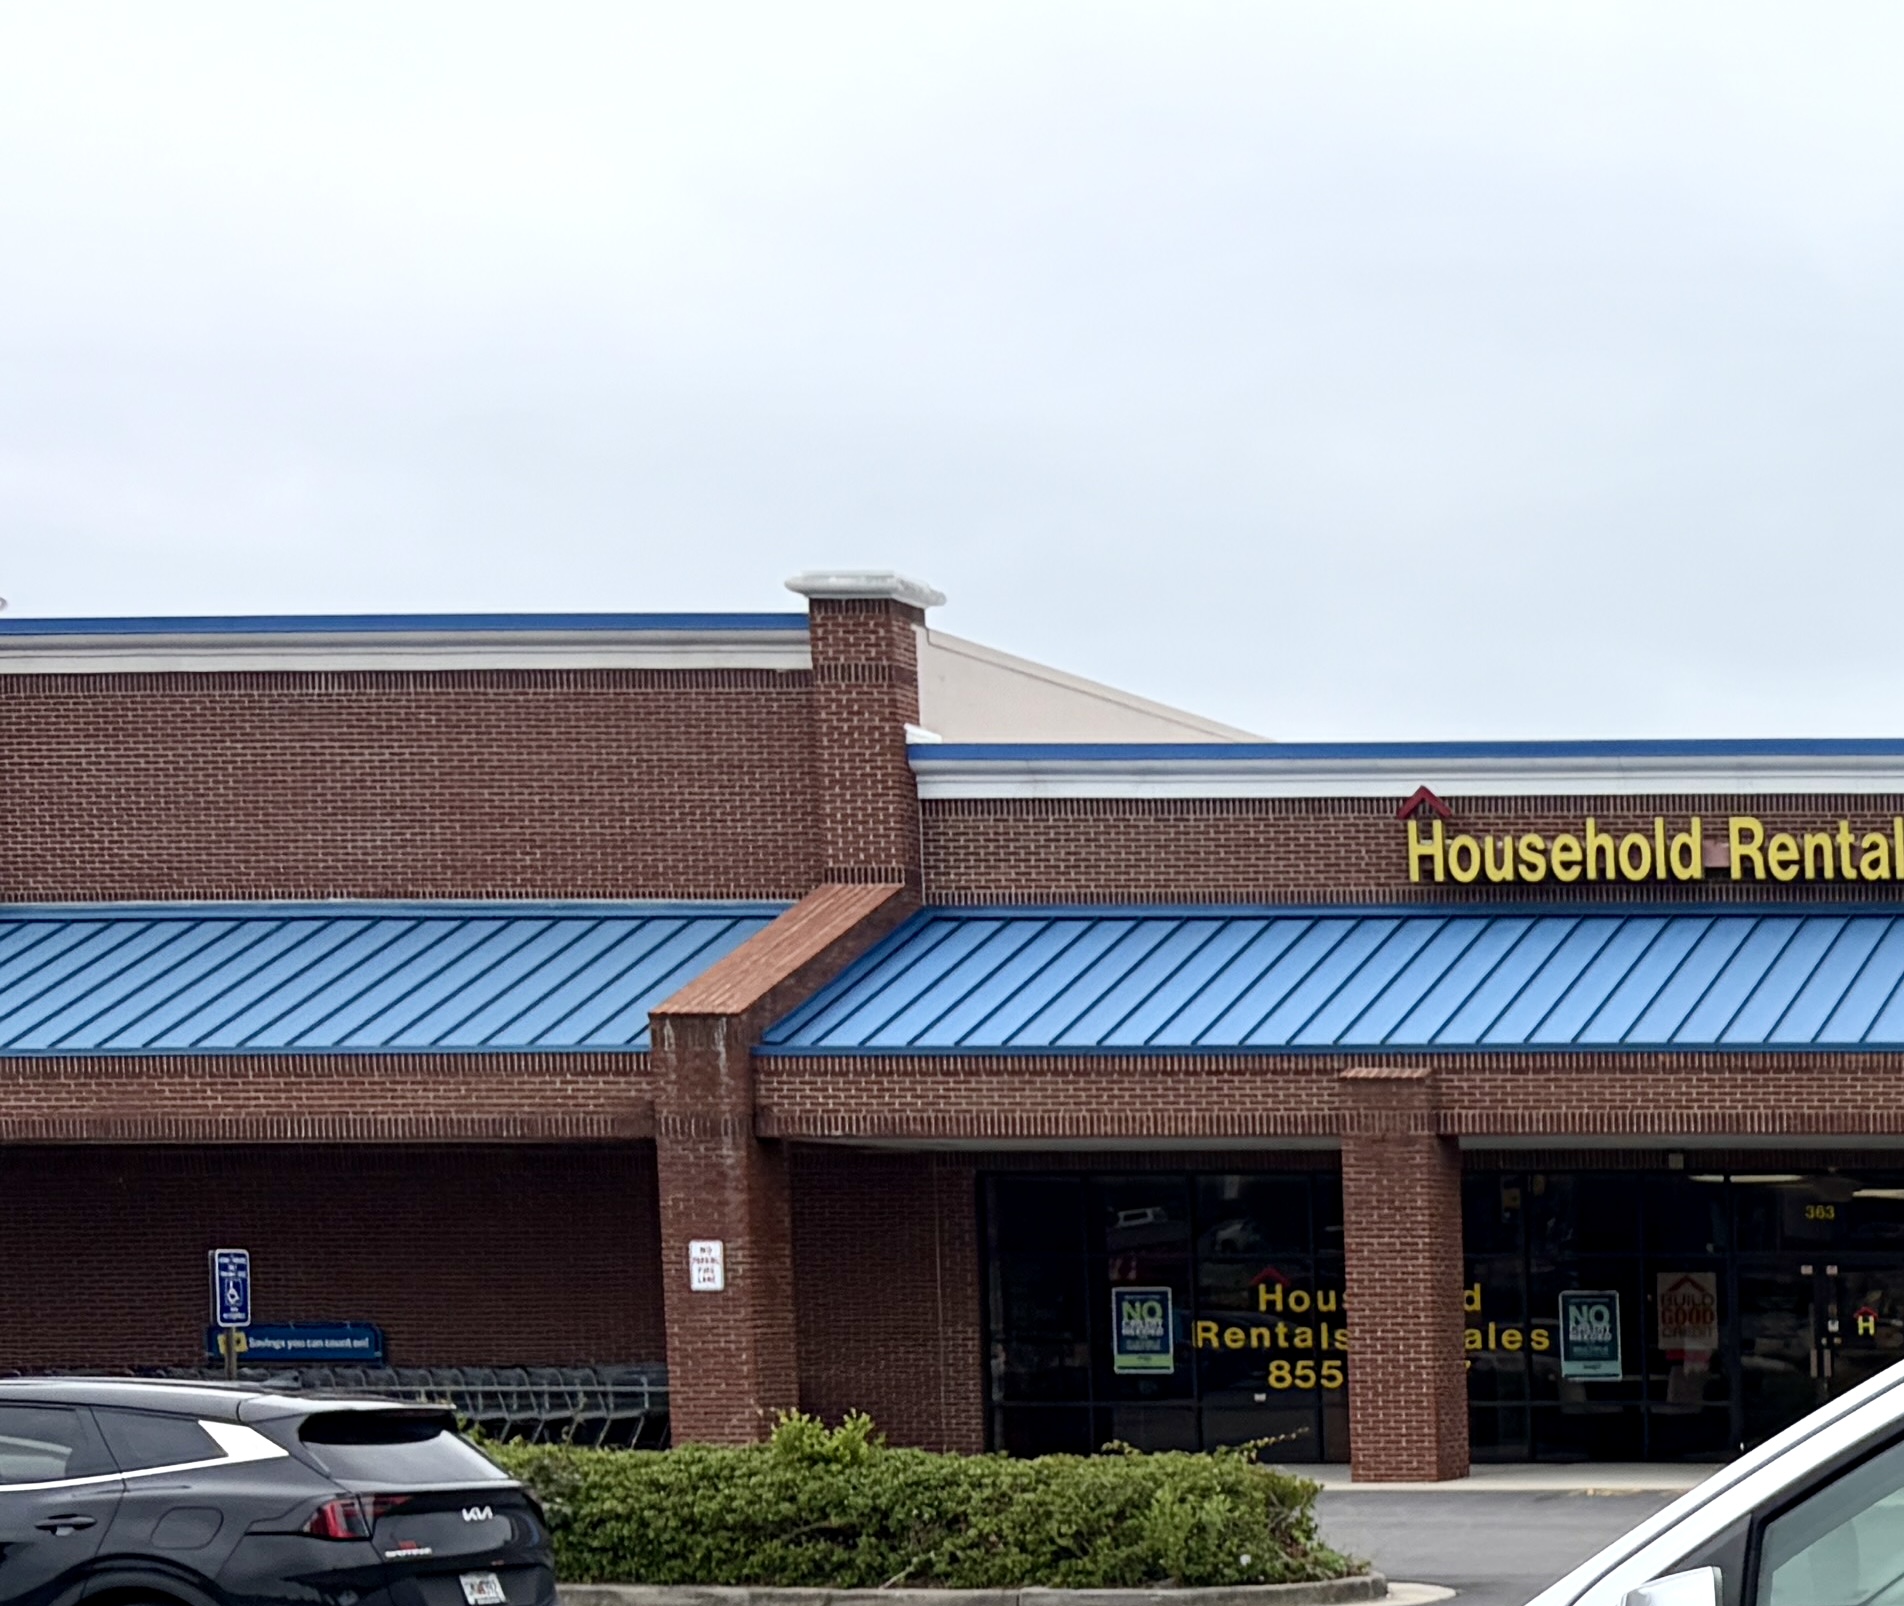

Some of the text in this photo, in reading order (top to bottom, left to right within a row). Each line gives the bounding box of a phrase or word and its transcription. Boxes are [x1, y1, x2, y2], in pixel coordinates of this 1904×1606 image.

[1407, 816, 1703, 882] Household
[1258, 1283, 1481, 1312] Hou d
[1122, 1301, 1162, 1320] NO
[1569, 1305, 1610, 1325] NO
[1662, 1307, 1714, 1324] GOOD
[1464, 1322, 1550, 1351] ales
